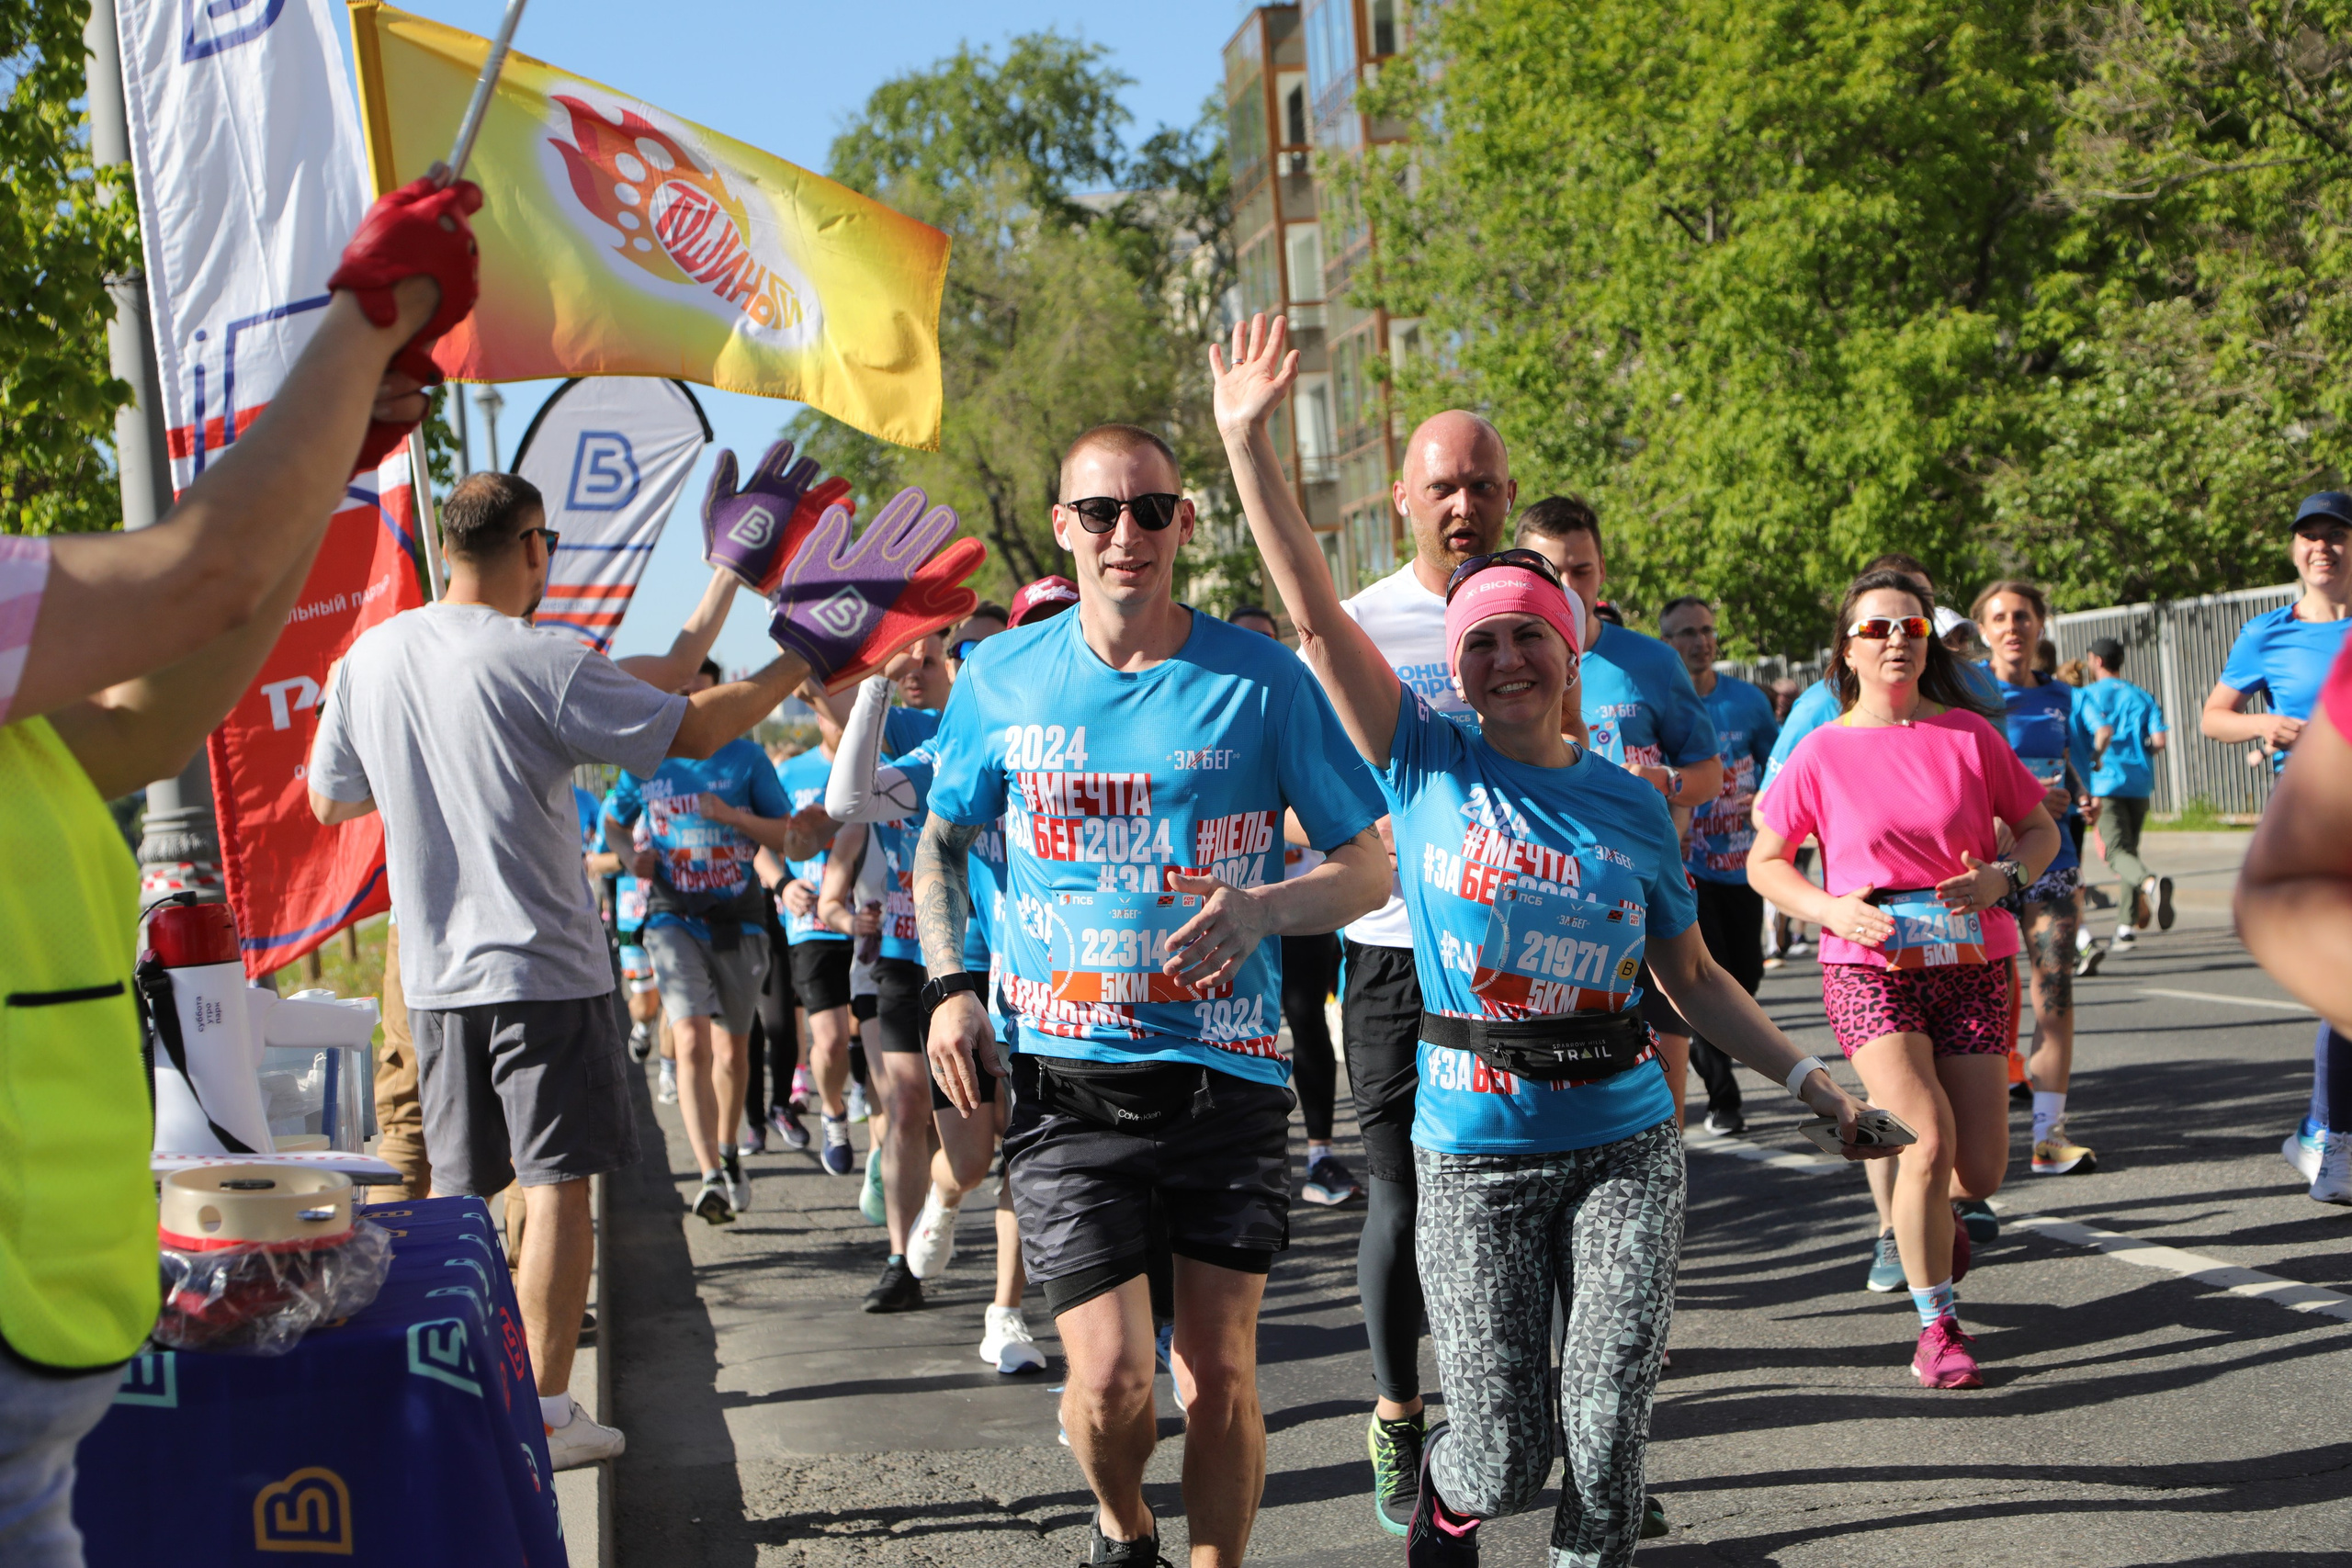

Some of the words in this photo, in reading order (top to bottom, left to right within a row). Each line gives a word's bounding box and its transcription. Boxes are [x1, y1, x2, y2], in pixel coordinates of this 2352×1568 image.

[1004, 724, 1089, 771] 2024
[1019, 772, 1152, 817] #МЕЧТА
[1458, 786, 1531, 840] 2024
[1461, 821, 1581, 888] #МЕЧТА
[1072, 896, 1093, 906] ПСБ
[1519, 893, 1544, 906] ПСБ
[1080, 928, 1170, 967] 22314
[1905, 913, 1968, 943] 22418
[1516, 930, 1610, 984] 21971
[195, 996, 205, 1032] суббота
[206, 1002, 214, 1024] утро
[214, 1001, 222, 1024] парк
[1194, 993, 1265, 1041] 2024
